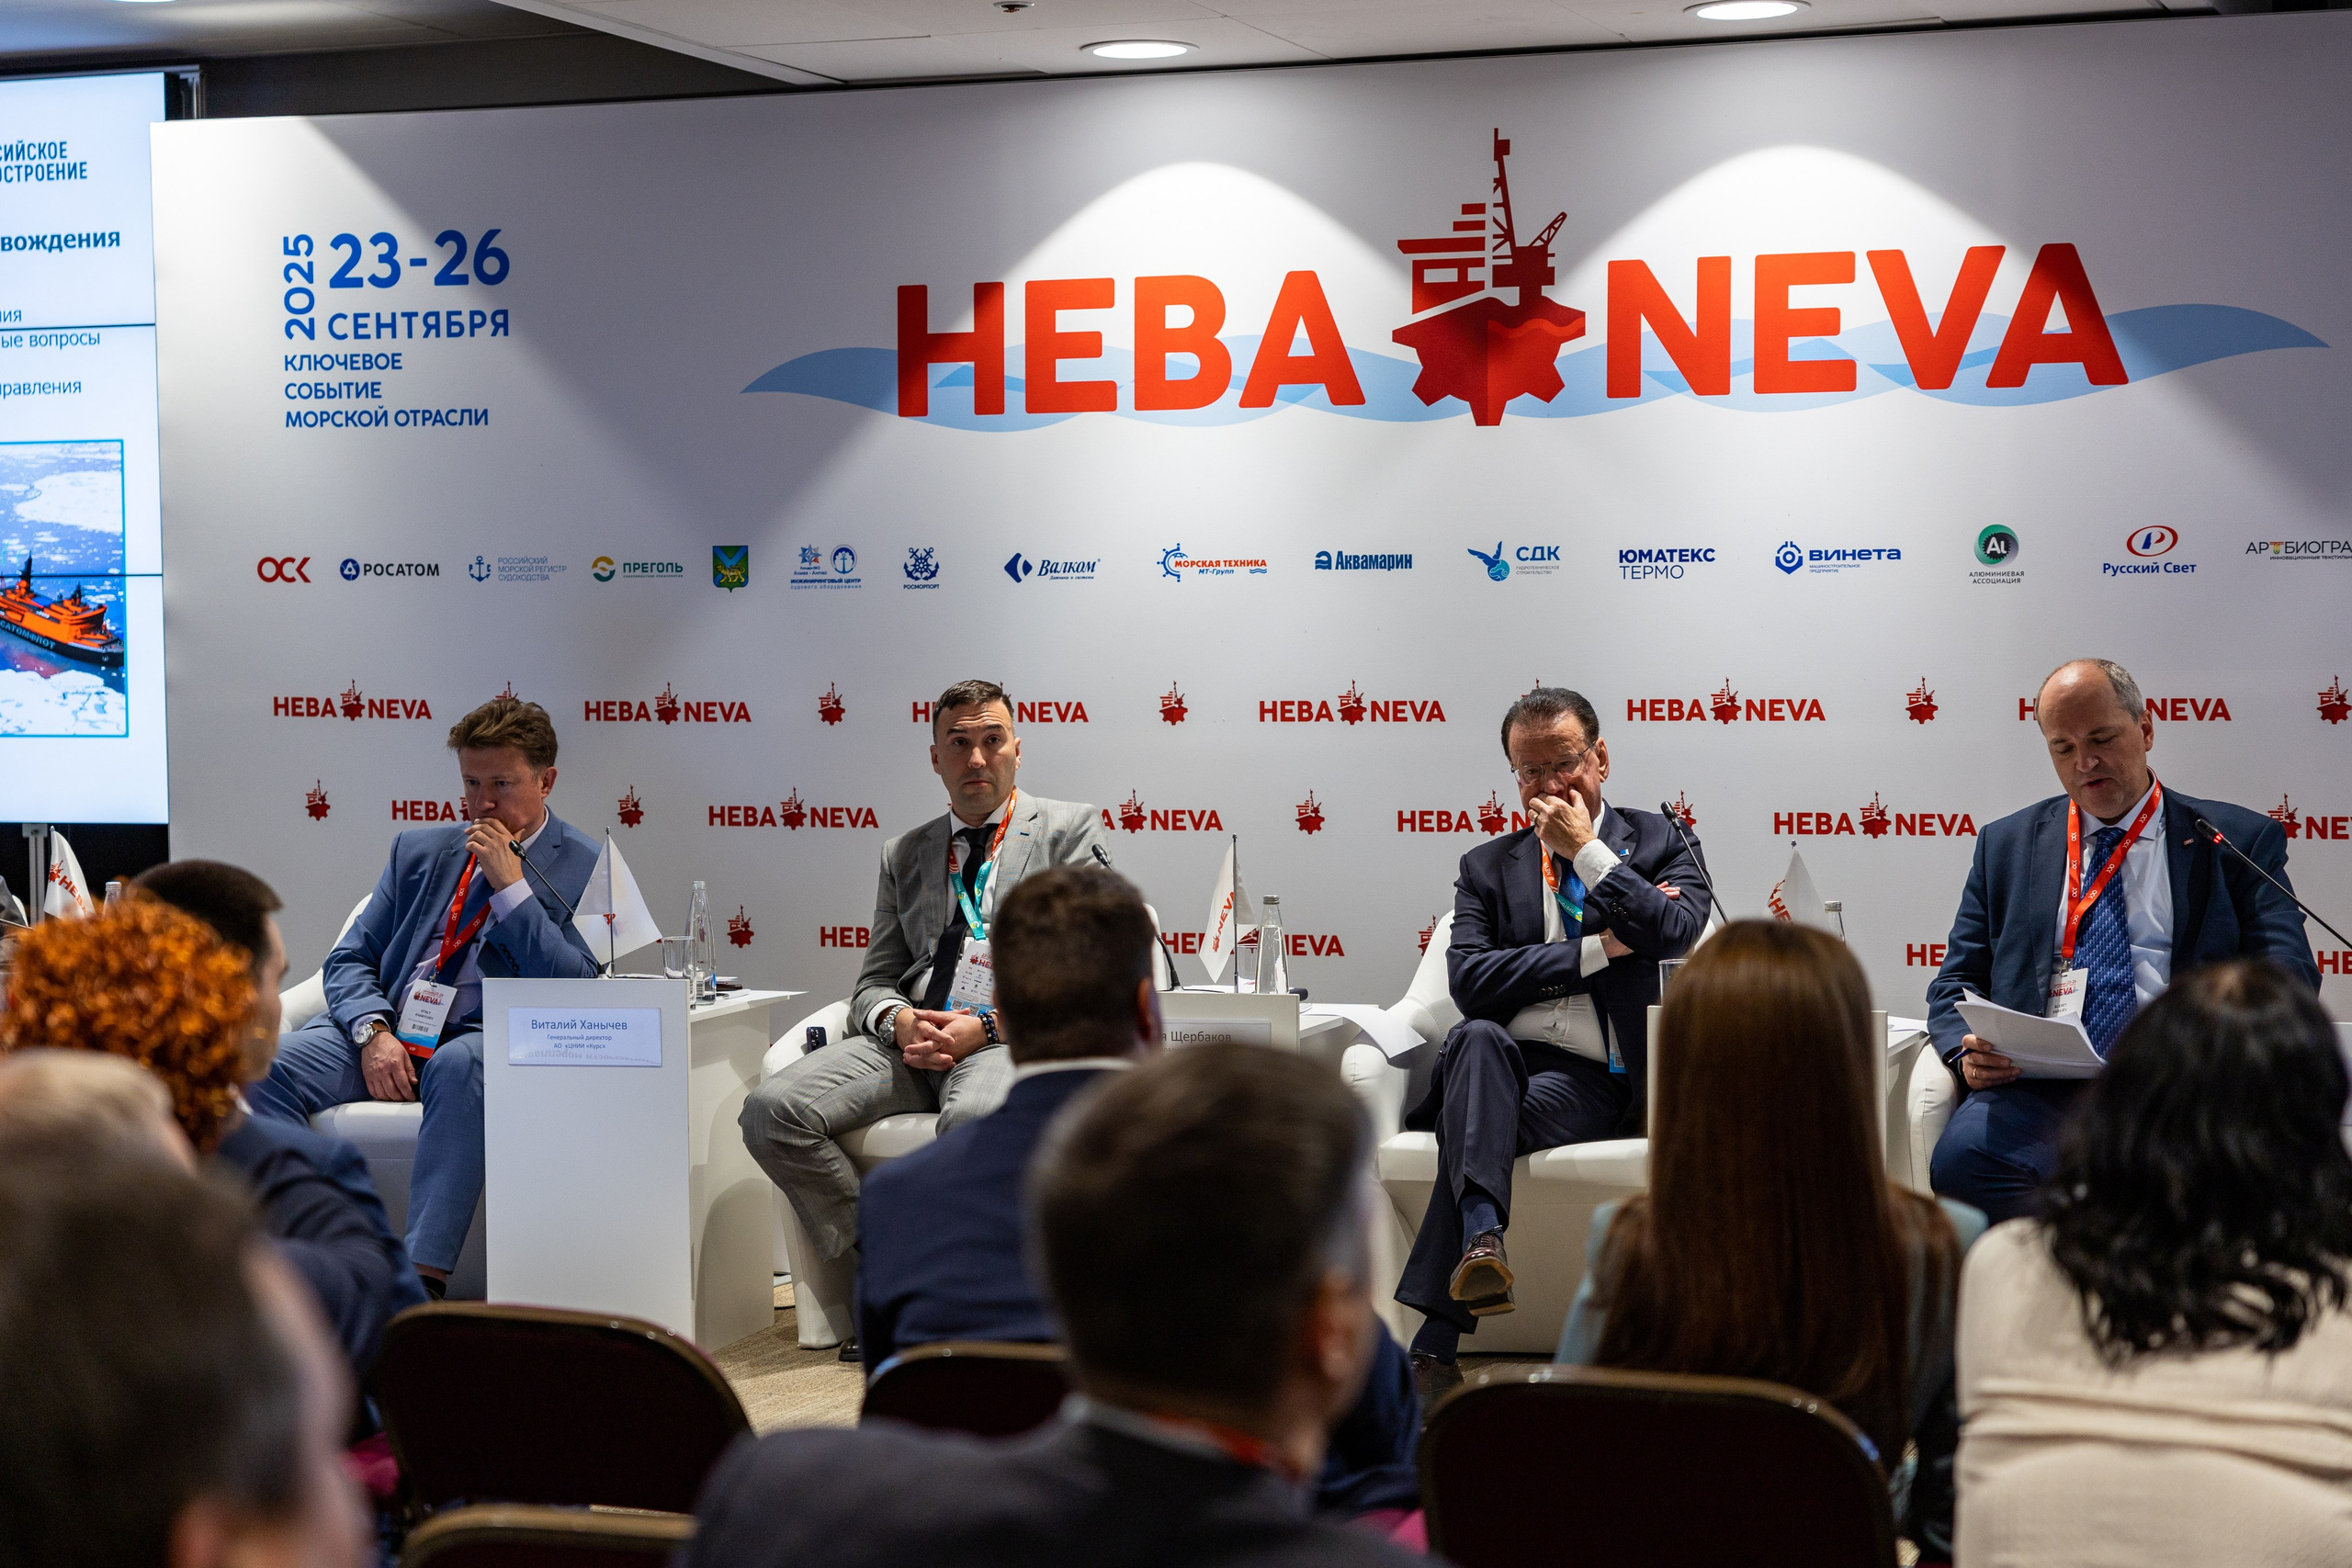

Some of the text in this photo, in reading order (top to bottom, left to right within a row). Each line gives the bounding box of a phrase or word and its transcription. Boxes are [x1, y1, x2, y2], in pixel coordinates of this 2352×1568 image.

[0, 140, 67, 163] ИЙСКОЕ
[0, 162, 87, 183] СТРОЕНИЕ
[0, 231, 120, 253] вождения
[329, 229, 510, 288] 23-26
[283, 234, 314, 341] 2025
[0, 310, 22, 323] ия
[328, 309, 509, 341] СЕНТЯБРЯ
[1607, 243, 2129, 399] NEVA
[29, 333, 100, 350] вопросы
[898, 271, 1365, 418] НЕВА
[284, 353, 402, 371] КЛЮЧЕВОЕ
[0, 381, 82, 400] равления
[284, 381, 382, 400] СОБЫТИЕ
[285, 405, 489, 428] МОРСКОЙ ОТРАСЛИ
[1516, 546, 1561, 561] СДК
[1619, 548, 1716, 563] ЮМАТЕКС
[2245, 540, 2352, 555] АРТБИОГРА
[257, 557, 311, 583] ОСК
[363, 563, 440, 577] РОСАТОМ
[623, 562, 684, 573] ПРЕГОЛЬ
[1223, 559, 1267, 568] ТЕХНИКА
[1335, 551, 1413, 571] Аквамарин
[2103, 562, 2197, 577] Русский Свет
[1619, 565, 1684, 580] ТЕРМО
[273, 696, 337, 717] НЕВА
[368, 698, 432, 719] NEVA
[584, 701, 651, 722] НЕВА
[684, 702, 752, 723] NEVA
[1017, 702, 1089, 723] NEVA
[1259, 700, 1334, 722] НЕВА
[1371, 700, 1446, 722] NEVA
[1627, 698, 1707, 722] НЕВА
[1746, 698, 1826, 721] NEVA
[2146, 698, 2232, 721] NEVA
[391, 800, 457, 822] НЕВА
[708, 806, 777, 828] НЕВА
[810, 807, 879, 829] NEVA
[1150, 809, 1223, 831] NEVA
[1397, 810, 1475, 833] НЕВА
[1774, 812, 1856, 835] НЕВА
[1895, 813, 1978, 837] NEVA
[820, 926, 870, 948] НЕВ
[531, 1020, 628, 1031] Виталий Ханычев
[1170, 1031, 1232, 1043] Щербаков
